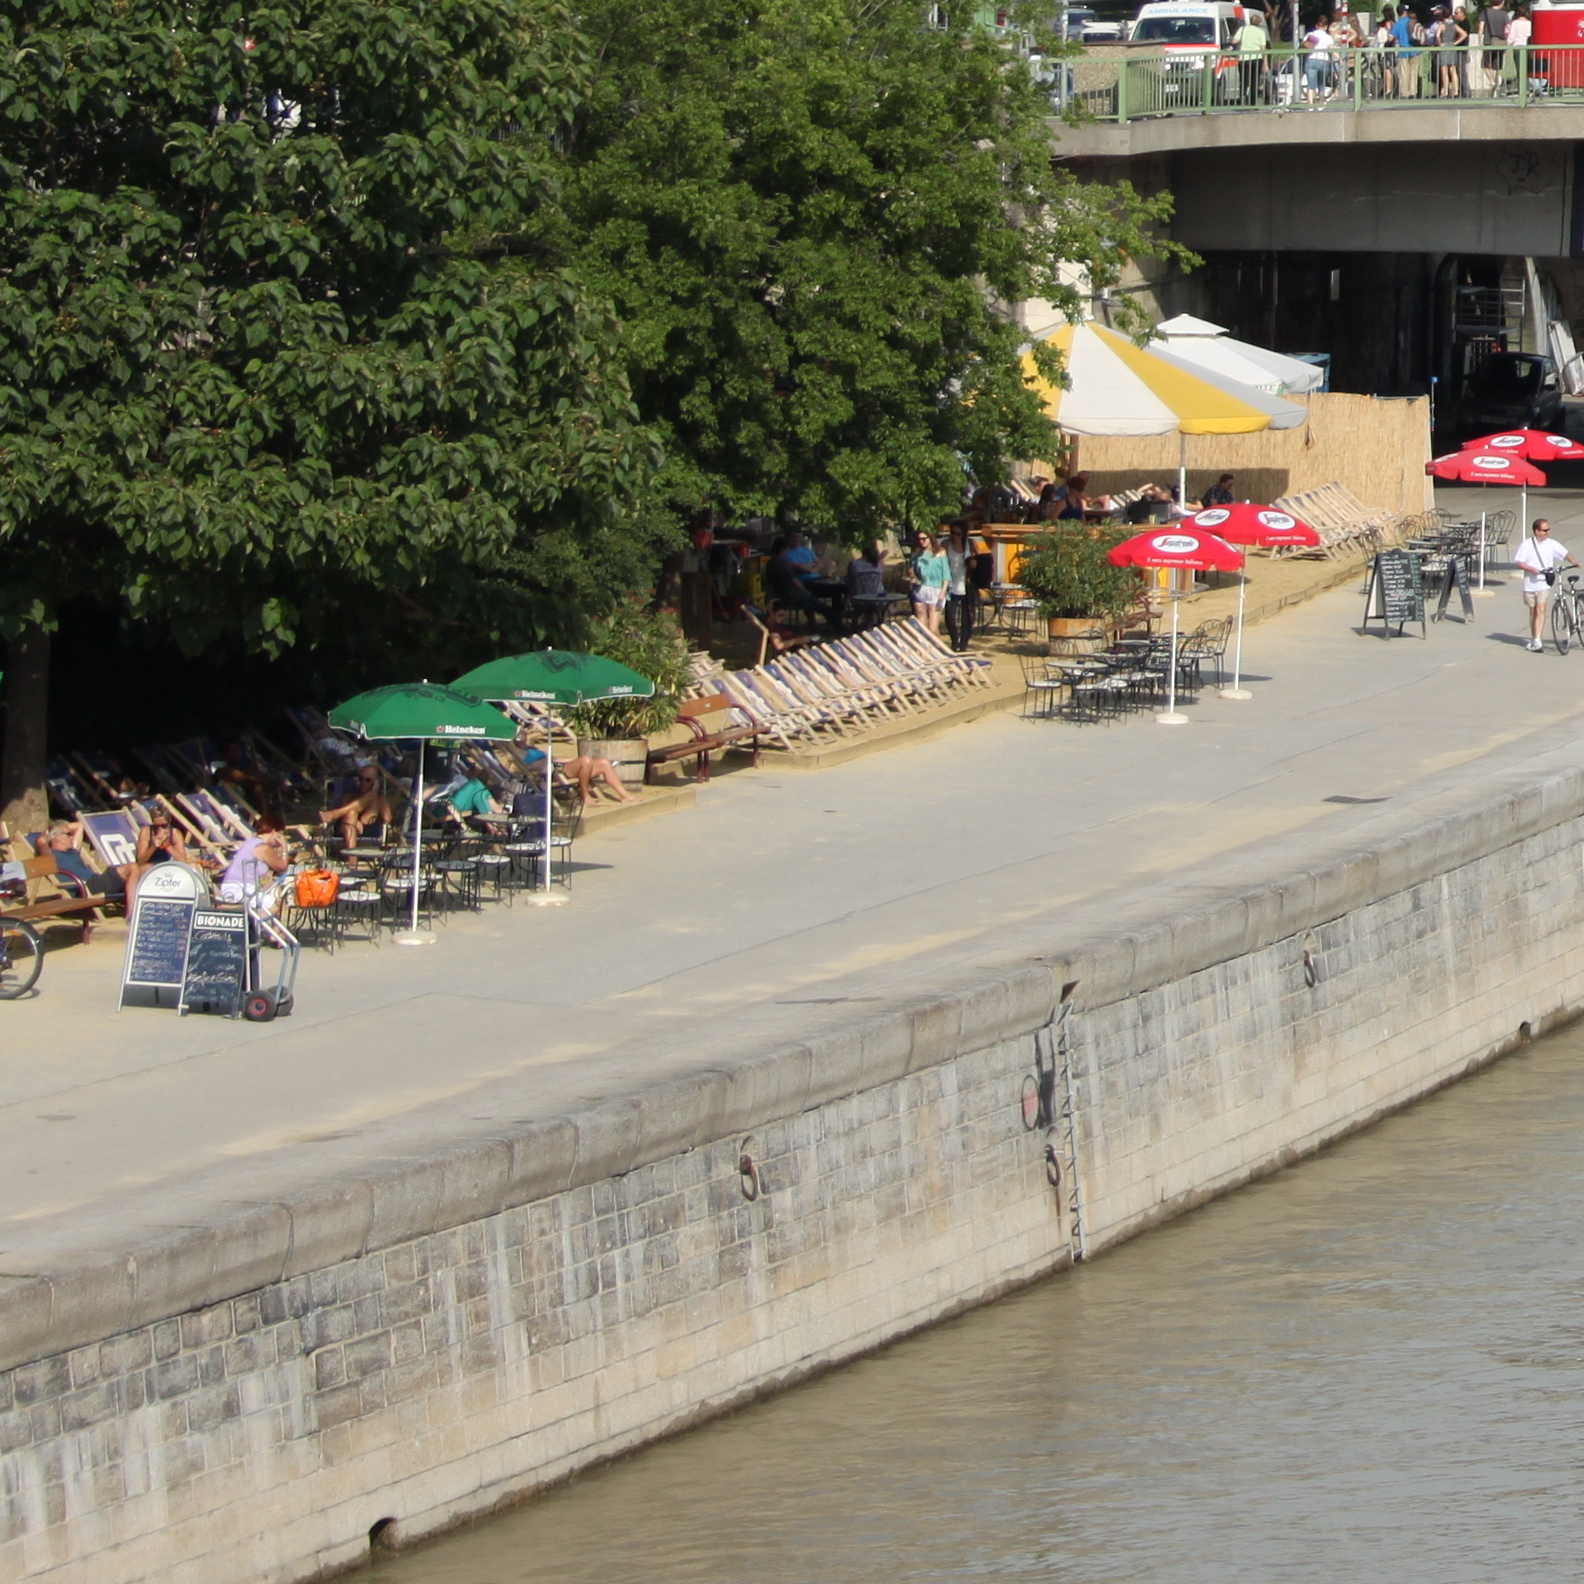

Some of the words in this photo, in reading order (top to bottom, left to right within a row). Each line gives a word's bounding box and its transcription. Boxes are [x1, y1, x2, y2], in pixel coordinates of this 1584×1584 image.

[521, 689, 556, 700] Heineken
[444, 724, 487, 735] Heineken
[154, 876, 183, 889] Zipfer
[197, 915, 244, 929] BIONADE
